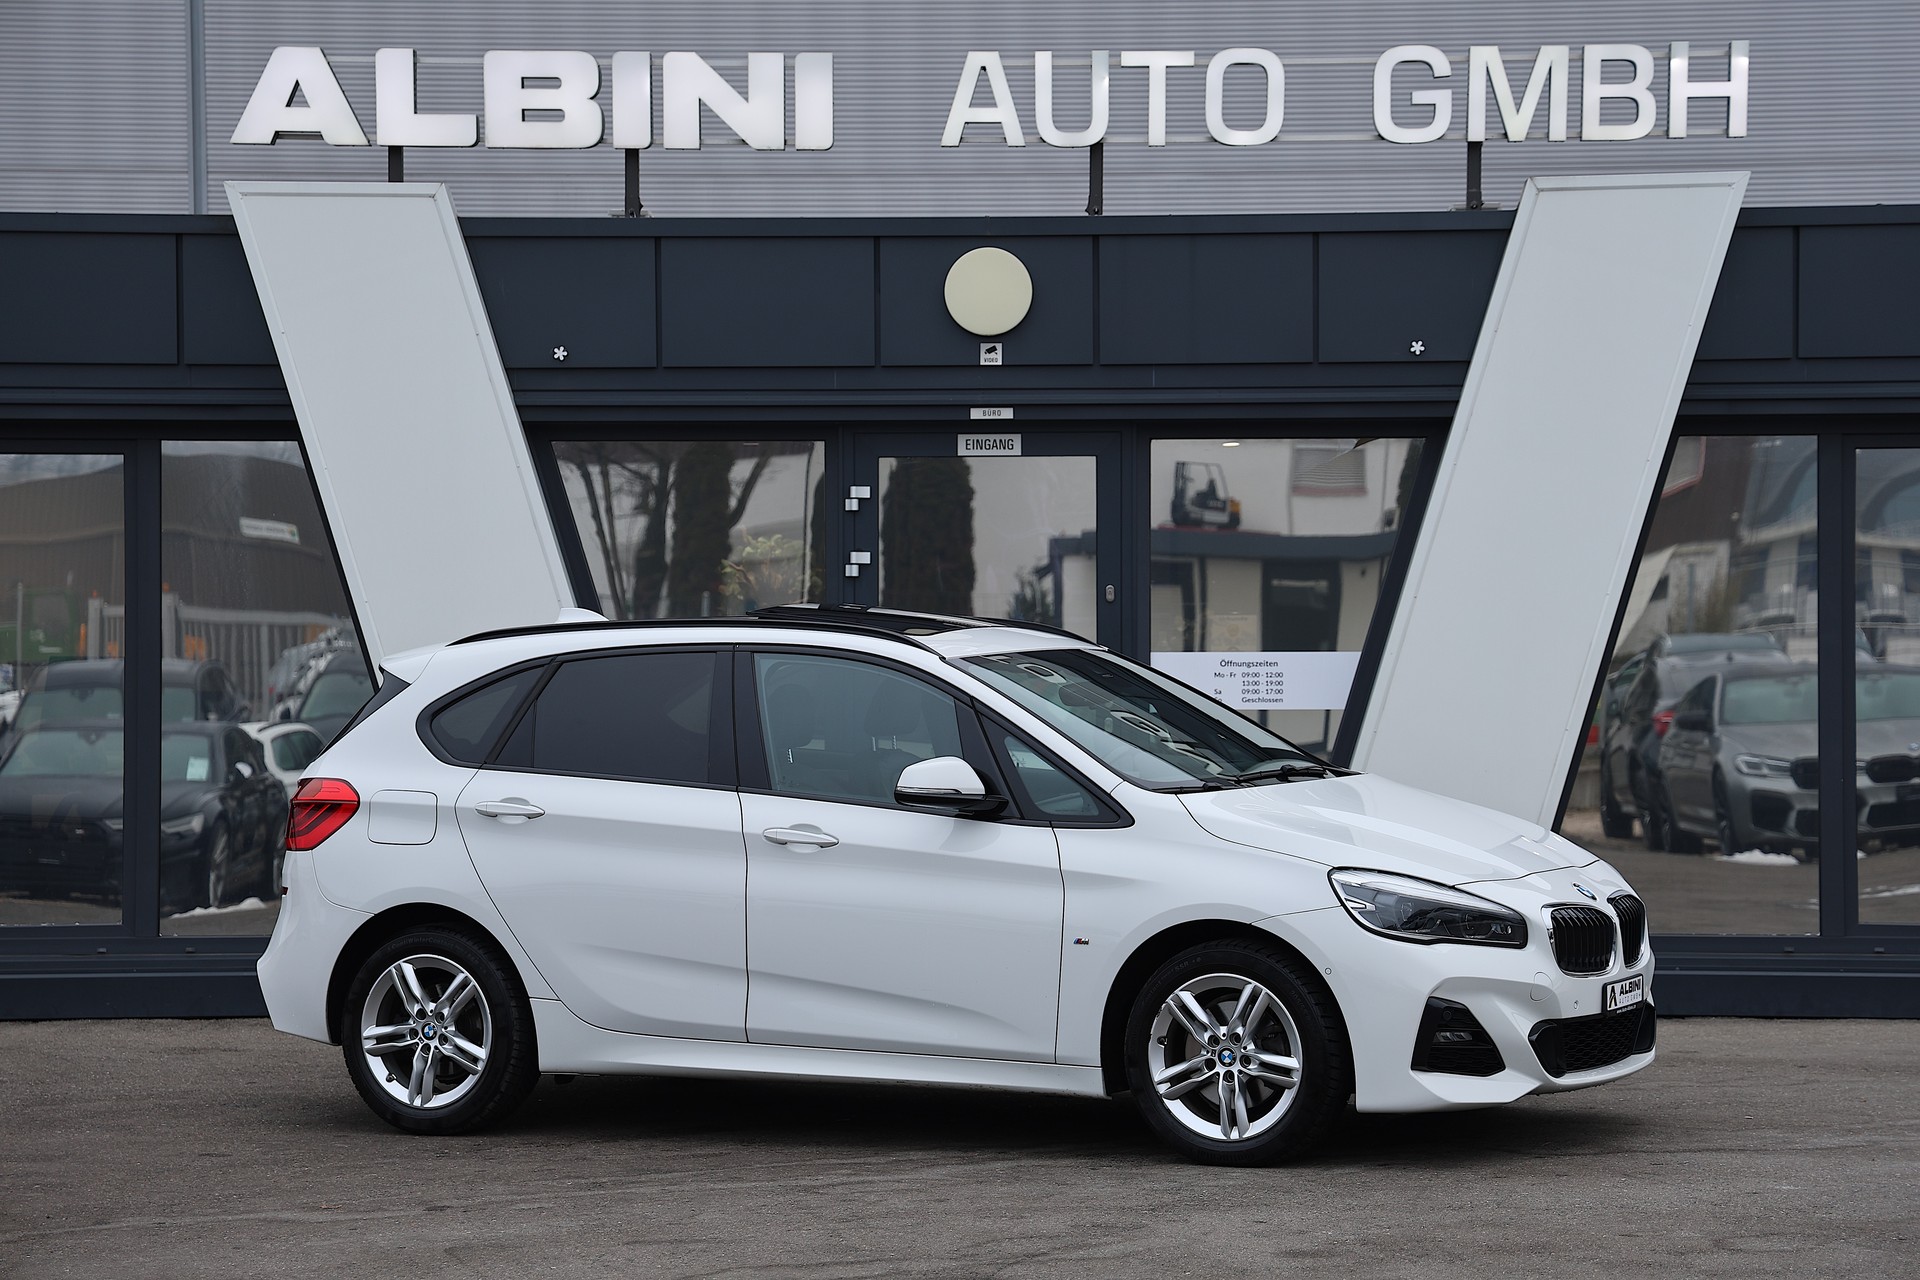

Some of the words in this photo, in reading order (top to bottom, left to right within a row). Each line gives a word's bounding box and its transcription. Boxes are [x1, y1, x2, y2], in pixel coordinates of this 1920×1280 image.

[230, 46, 833, 151] ALBINI
[941, 47, 1286, 148] AUTO
[1373, 41, 1750, 144] GMBH
[982, 409, 1002, 417] BÜRO
[965, 438, 1014, 451] EINGANG
[1219, 659, 1278, 668] Öffnungszeiten
